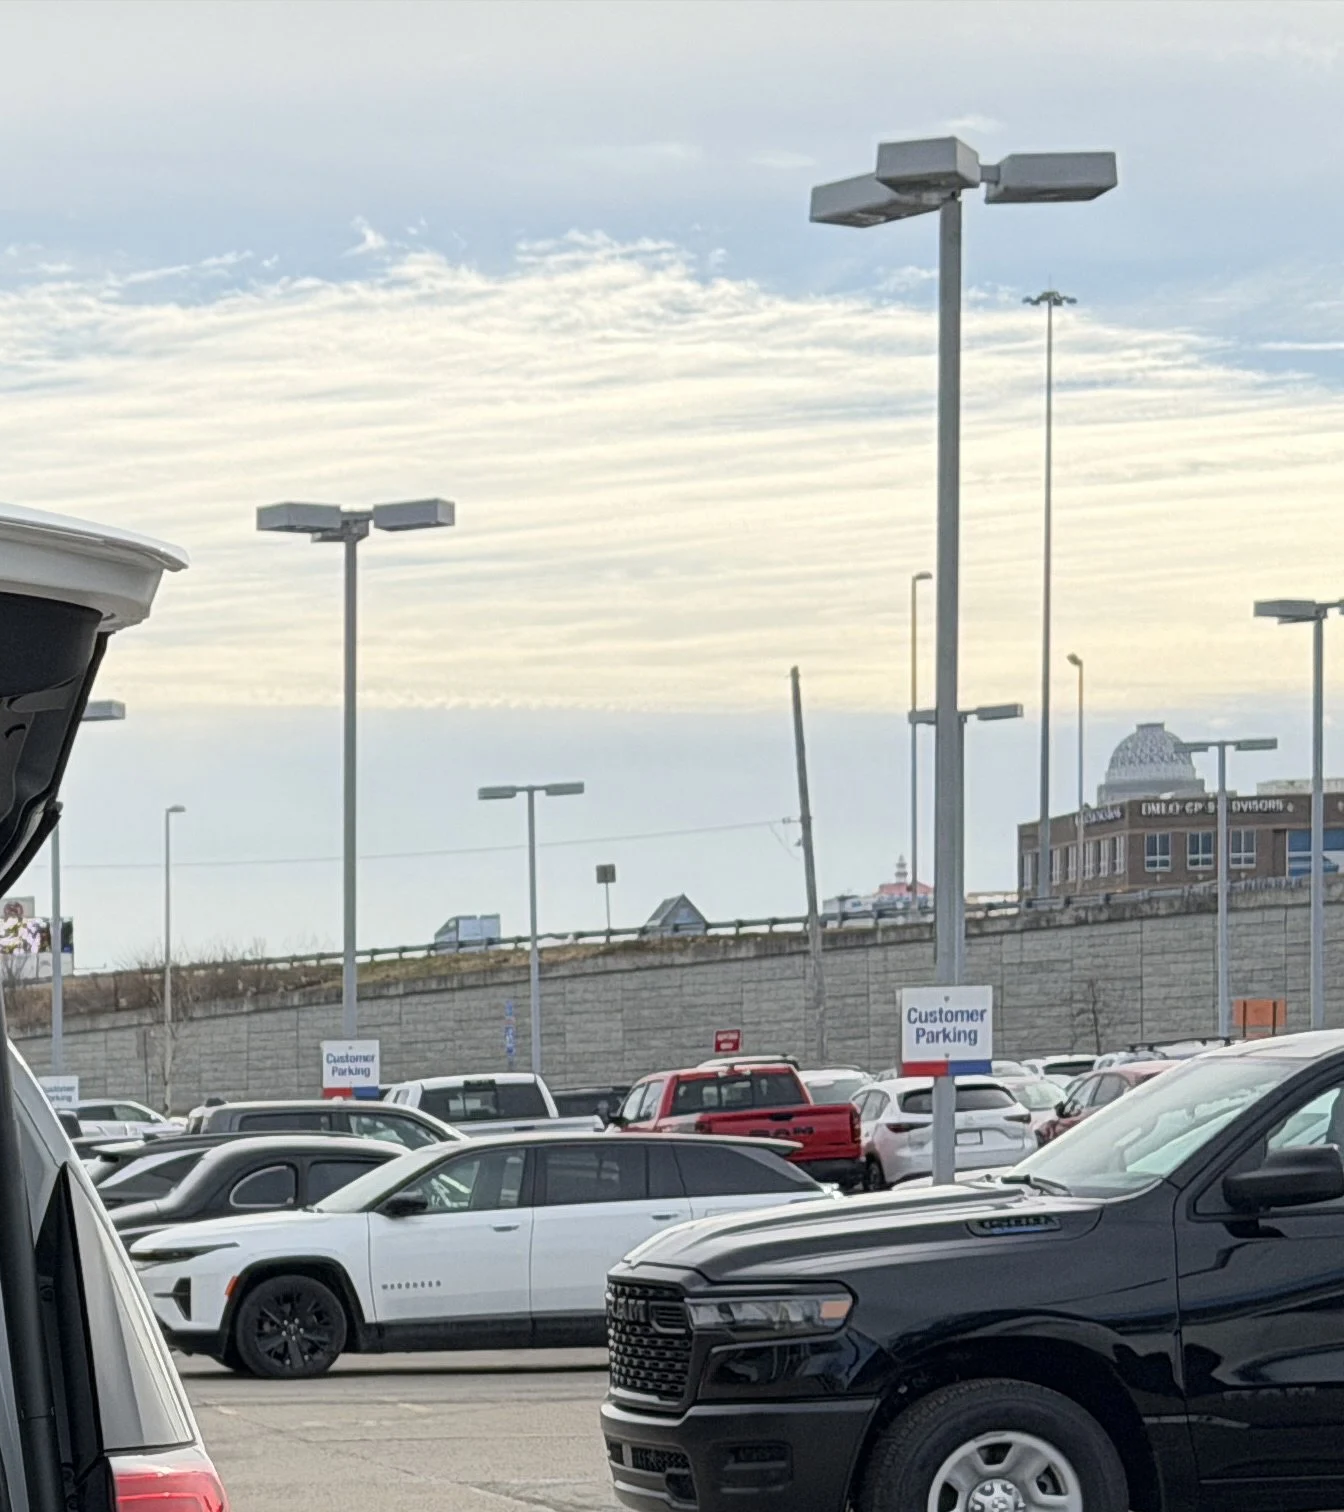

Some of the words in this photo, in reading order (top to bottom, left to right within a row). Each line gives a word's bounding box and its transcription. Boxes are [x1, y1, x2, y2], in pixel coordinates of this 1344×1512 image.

[907, 1007, 987, 1024] Customer
[915, 1026, 978, 1047] Parking
[326, 1052, 375, 1064] Customer
[332, 1066, 371, 1078] Parking
